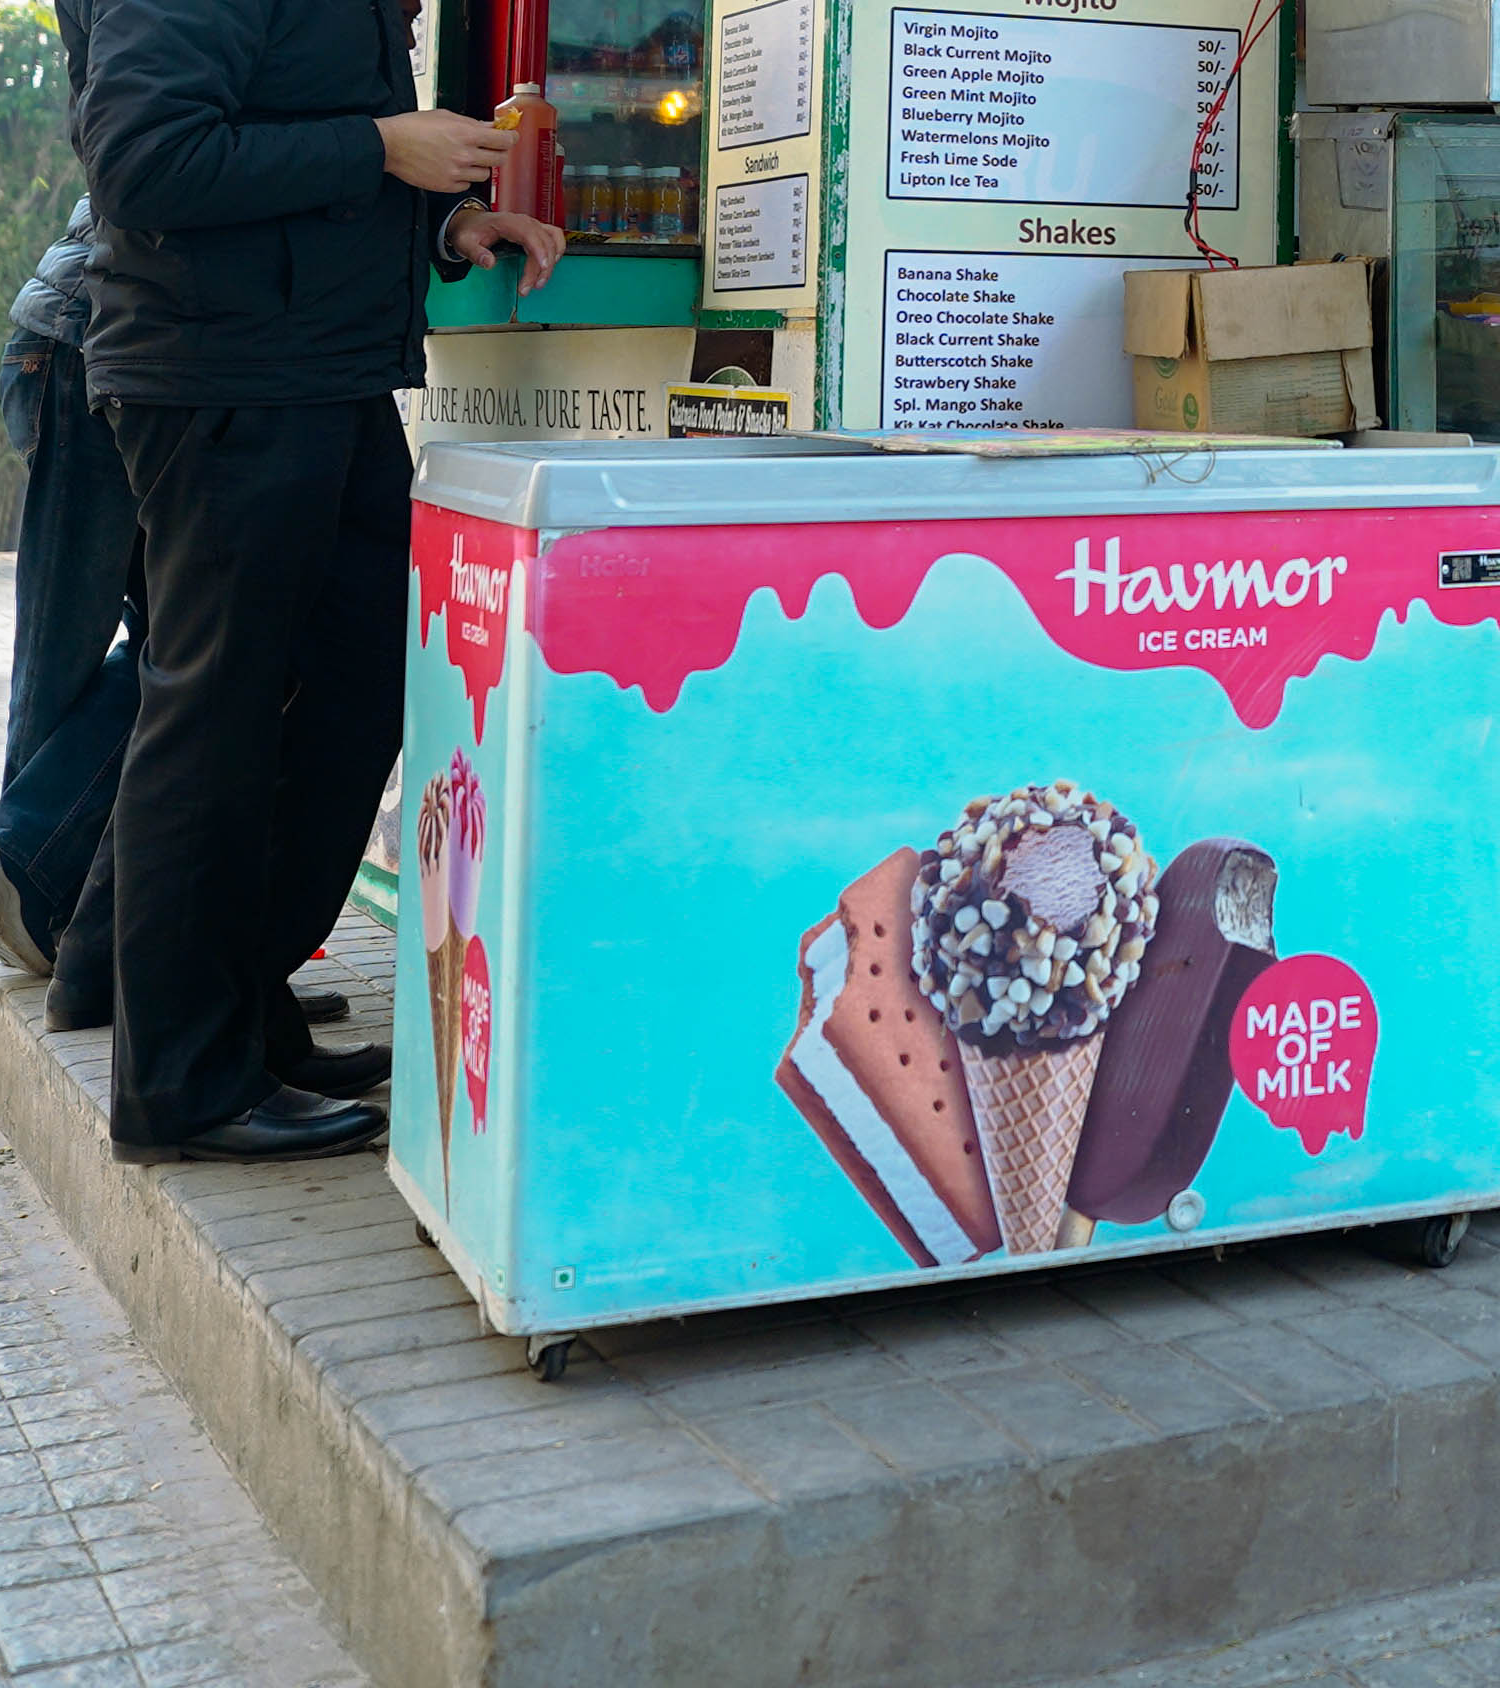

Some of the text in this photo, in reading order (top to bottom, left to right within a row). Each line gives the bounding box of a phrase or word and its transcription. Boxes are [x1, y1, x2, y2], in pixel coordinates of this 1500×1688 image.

[904, 43, 1051, 65] Black Current Mojito
[901, 129, 1050, 149] Watermelons Mojito
[745, 151, 779, 174] Sandwich
[900, 150, 1017, 167] Fresh Lime Sode
[1018, 217, 1116, 245] Shakes
[895, 354, 1033, 368] Butterscotch Shake
[894, 375, 1016, 392] Strawbery Shake
[421, 387, 651, 432] PURE AROMA. PURE TASTE.
[449, 531, 508, 615] Havmor
[1054, 535, 1348, 617] Havmor
[1138, 626, 1268, 653] ICE CREAM
[463, 972, 490, 1012] MADE
[468, 1008, 489, 1039] OF
[1247, 995, 1362, 1040] MADE
[464, 1035, 487, 1083] MILK
[1276, 1029, 1333, 1067] OF
[1257, 1059, 1352, 1102] MILK
